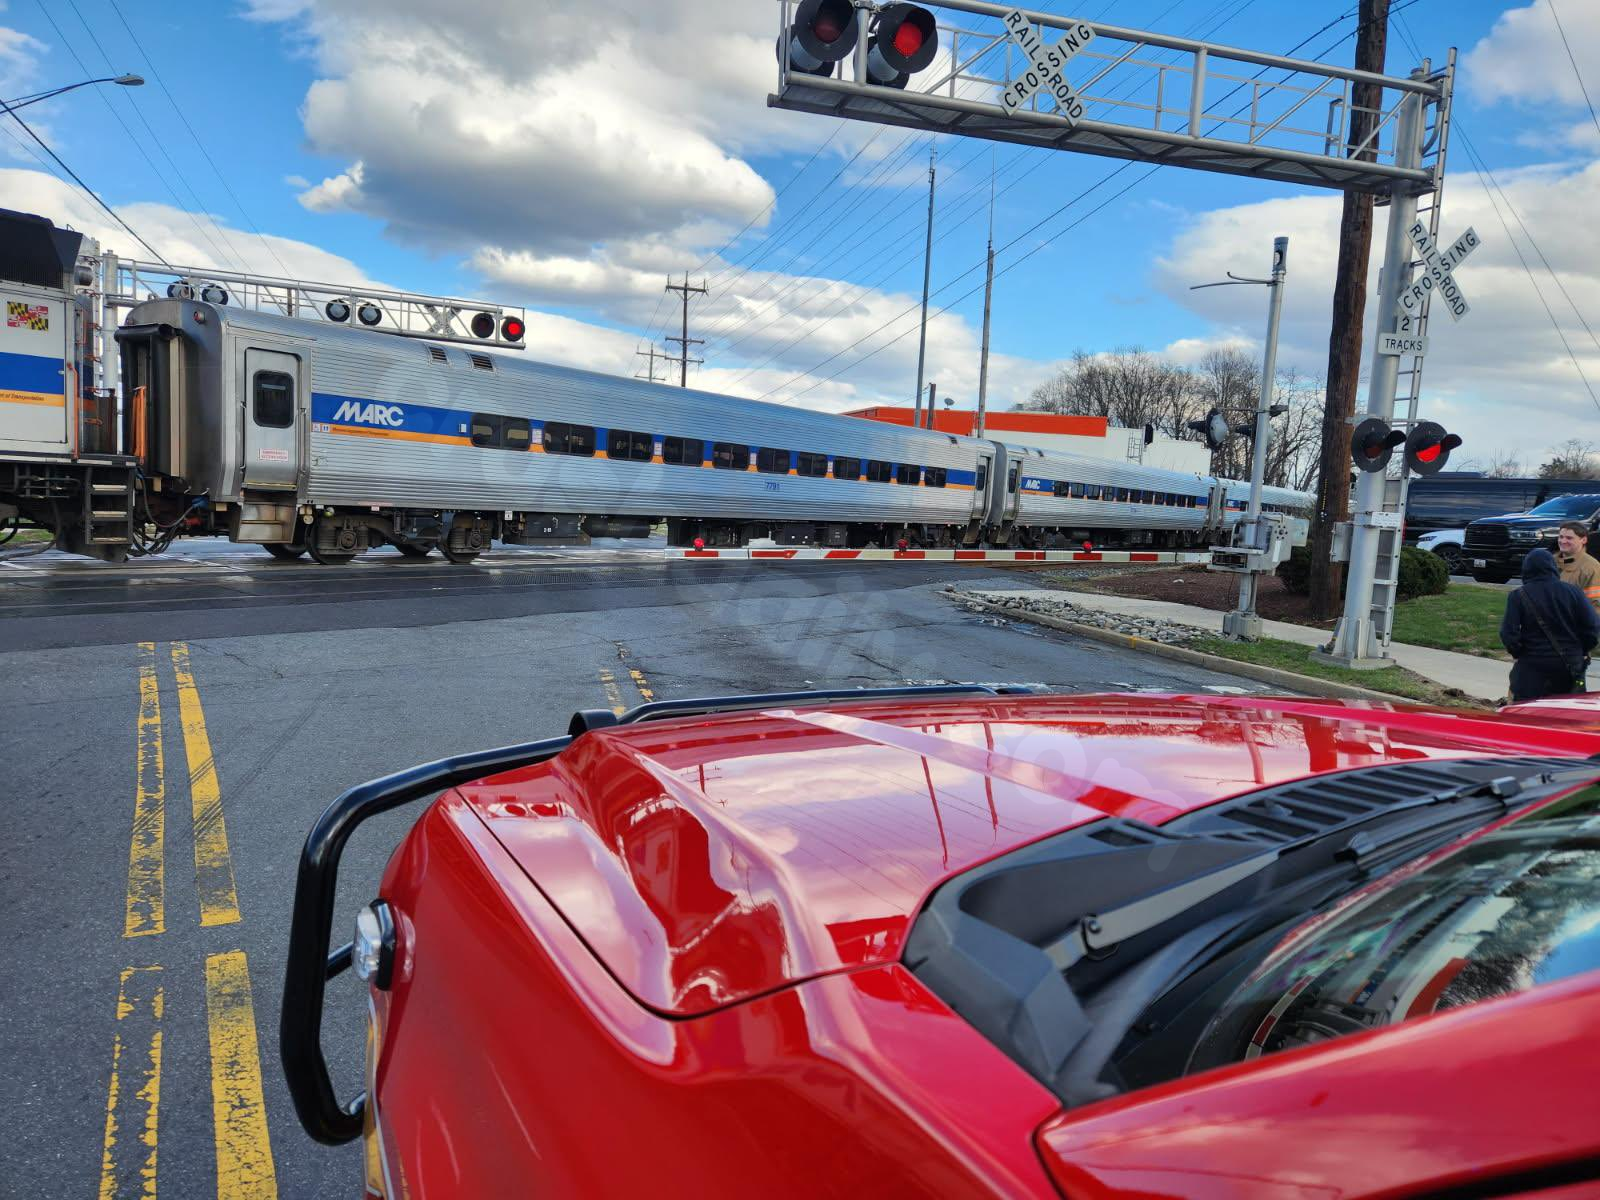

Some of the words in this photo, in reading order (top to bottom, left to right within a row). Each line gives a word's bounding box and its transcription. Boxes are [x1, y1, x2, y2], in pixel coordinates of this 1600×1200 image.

[1004, 25, 1090, 108] CROSSING
[1403, 233, 1476, 309] CROSSING
[1401, 318, 1410, 331] 2
[1385, 338, 1423, 351] TRACKS
[332, 401, 404, 427] MARC
